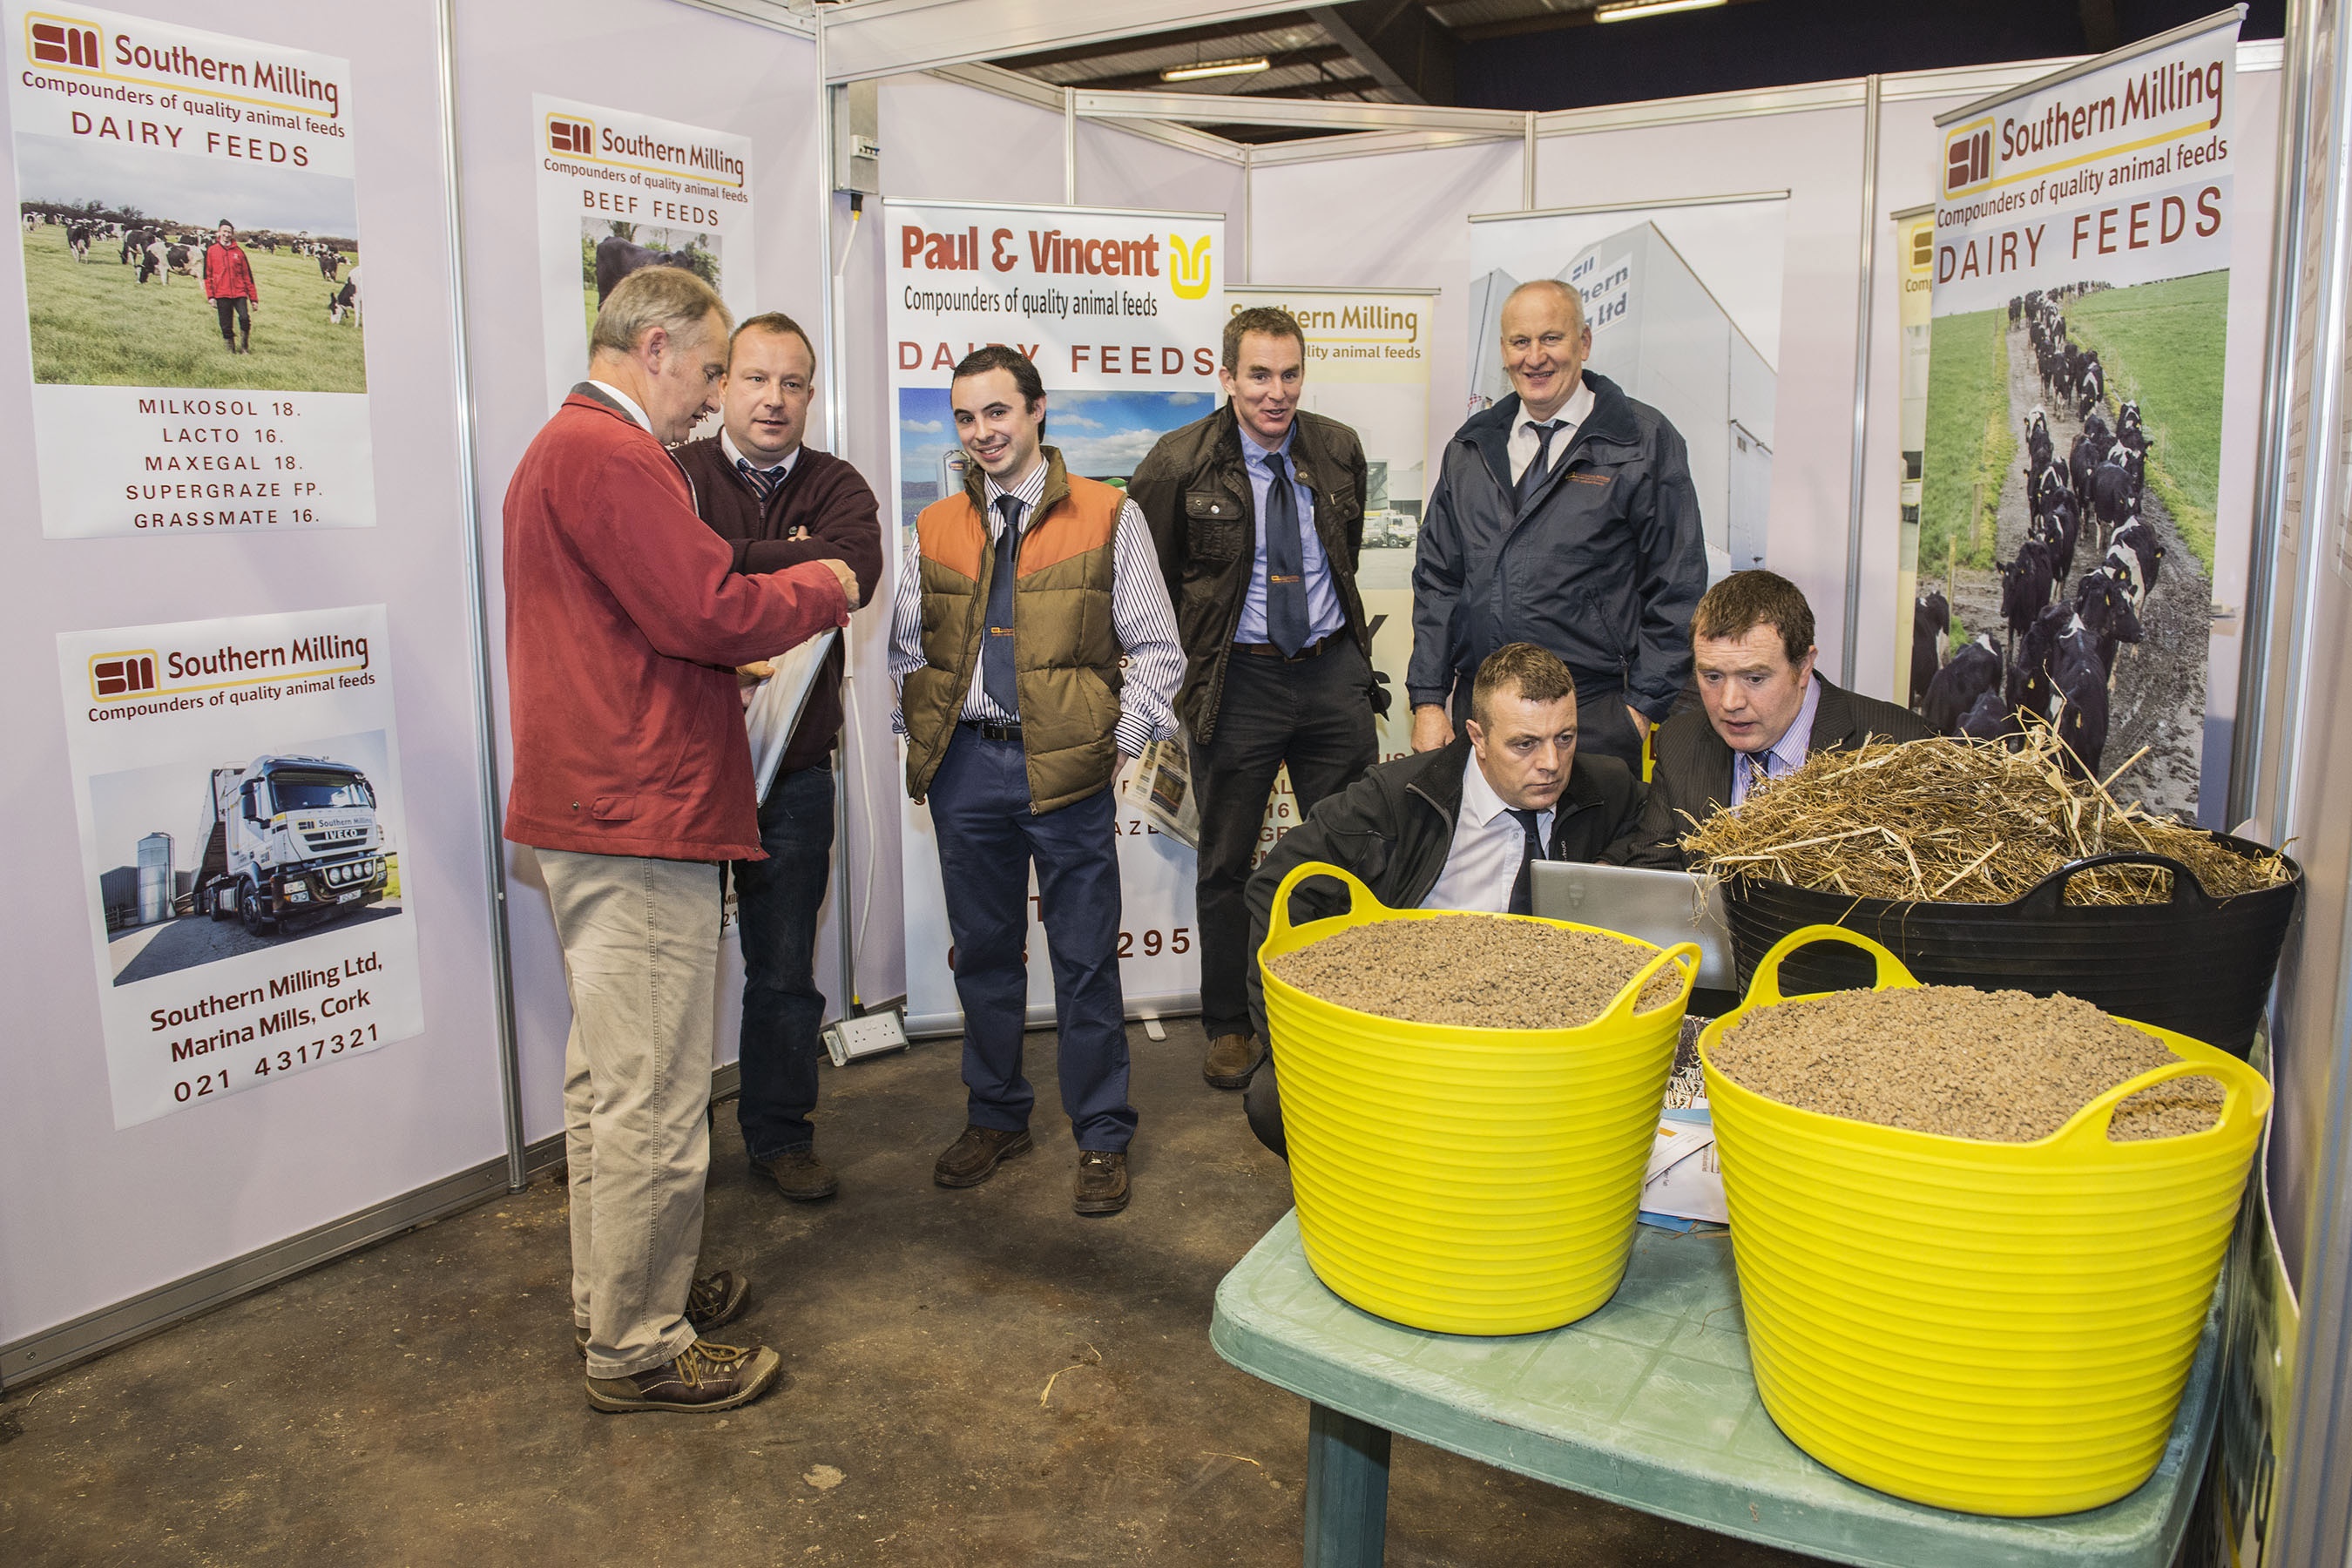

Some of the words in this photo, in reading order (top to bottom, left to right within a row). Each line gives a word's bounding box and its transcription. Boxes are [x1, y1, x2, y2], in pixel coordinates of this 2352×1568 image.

[115, 34, 247, 86] Southern
[253, 60, 338, 118] Milling
[23, 71, 153, 105] Compounders
[160, 94, 178, 110] of
[183, 100, 241, 123] quality
[247, 110, 301, 131] animal
[306, 118, 346, 138] feeds
[2002, 95, 2115, 162] Southern
[2122, 60, 2223, 130] Milling
[72, 111, 184, 148] DAIRY
[207, 132, 308, 167] FEEDS
[602, 128, 686, 165] Southern
[690, 145, 744, 187] Milling
[544, 158, 625, 182] Compounders
[630, 172, 641, 185] of
[645, 176, 681, 194] quality
[685, 182, 719, 198] animal
[722, 185, 748, 203] feeds
[1938, 190, 2025, 228] Compounders
[2031, 183, 2045, 203] of
[2050, 170, 2104, 204] quality
[2108, 147, 2172, 186] animal
[2177, 135, 2227, 170] feeds
[584, 190, 639, 213] BEEF
[653, 200, 719, 226] FEEDS
[902, 226, 979, 270] Paul
[992, 228, 1017, 272] &
[1029, 230, 1159, 277] Vincent
[1938, 223, 2046, 283] DAIRY
[2072, 186, 2222, 260] FEEDS
[904, 286, 1000, 316] Compounders
[1005, 287, 1018, 311] of
[1023, 288, 1069, 319] quality
[1073, 291, 1119, 315] animal
[1123, 293, 1158, 316] feeds
[1598, 292, 1627, 327] Ltd
[1342, 306, 1417, 342] Milling
[898, 341, 1040, 370] DAY
[1071, 346, 1214, 375] FEEDS
[1333, 346, 1380, 359] animal
[1385, 346, 1421, 359] feeds
[139, 399, 257, 416] MILKOSOL
[272, 402, 301, 416] 18.
[163, 428, 239, 443] LACTO
[254, 429, 284, 443] 16.
[145, 456, 261, 470] MAXEGAL
[274, 456, 303, 470] 18.
[126, 483, 280, 500] SUPERGRAZE
[294, 483, 322, 497] FP.
[134, 510, 278, 529] GRASSMATE
[292, 509, 320, 523] 16.
[167, 645, 286, 679] Southern
[292, 634, 368, 670] Milling
[88, 694, 204, 722] Compounders
[210, 691, 225, 706] of
[229, 686, 281, 708] quality
[286, 680, 335, 697] animal
[339, 672, 376, 689] feeds
[319, 818, 353, 828] Southern
[324, 829, 358, 840] IVECO
[1118, 928, 1191, 958] 295
[151, 988, 264, 1031] Southern
[269, 966, 340, 1000] Milling
[345, 951, 383, 978] Ltd,
[171, 1026, 254, 1062] Marina
[260, 1008, 316, 1037] Mills,
[321, 989, 371, 1017] Cork
[174, 1069, 230, 1102] 021
[254, 1023, 378, 1077] 4317321
